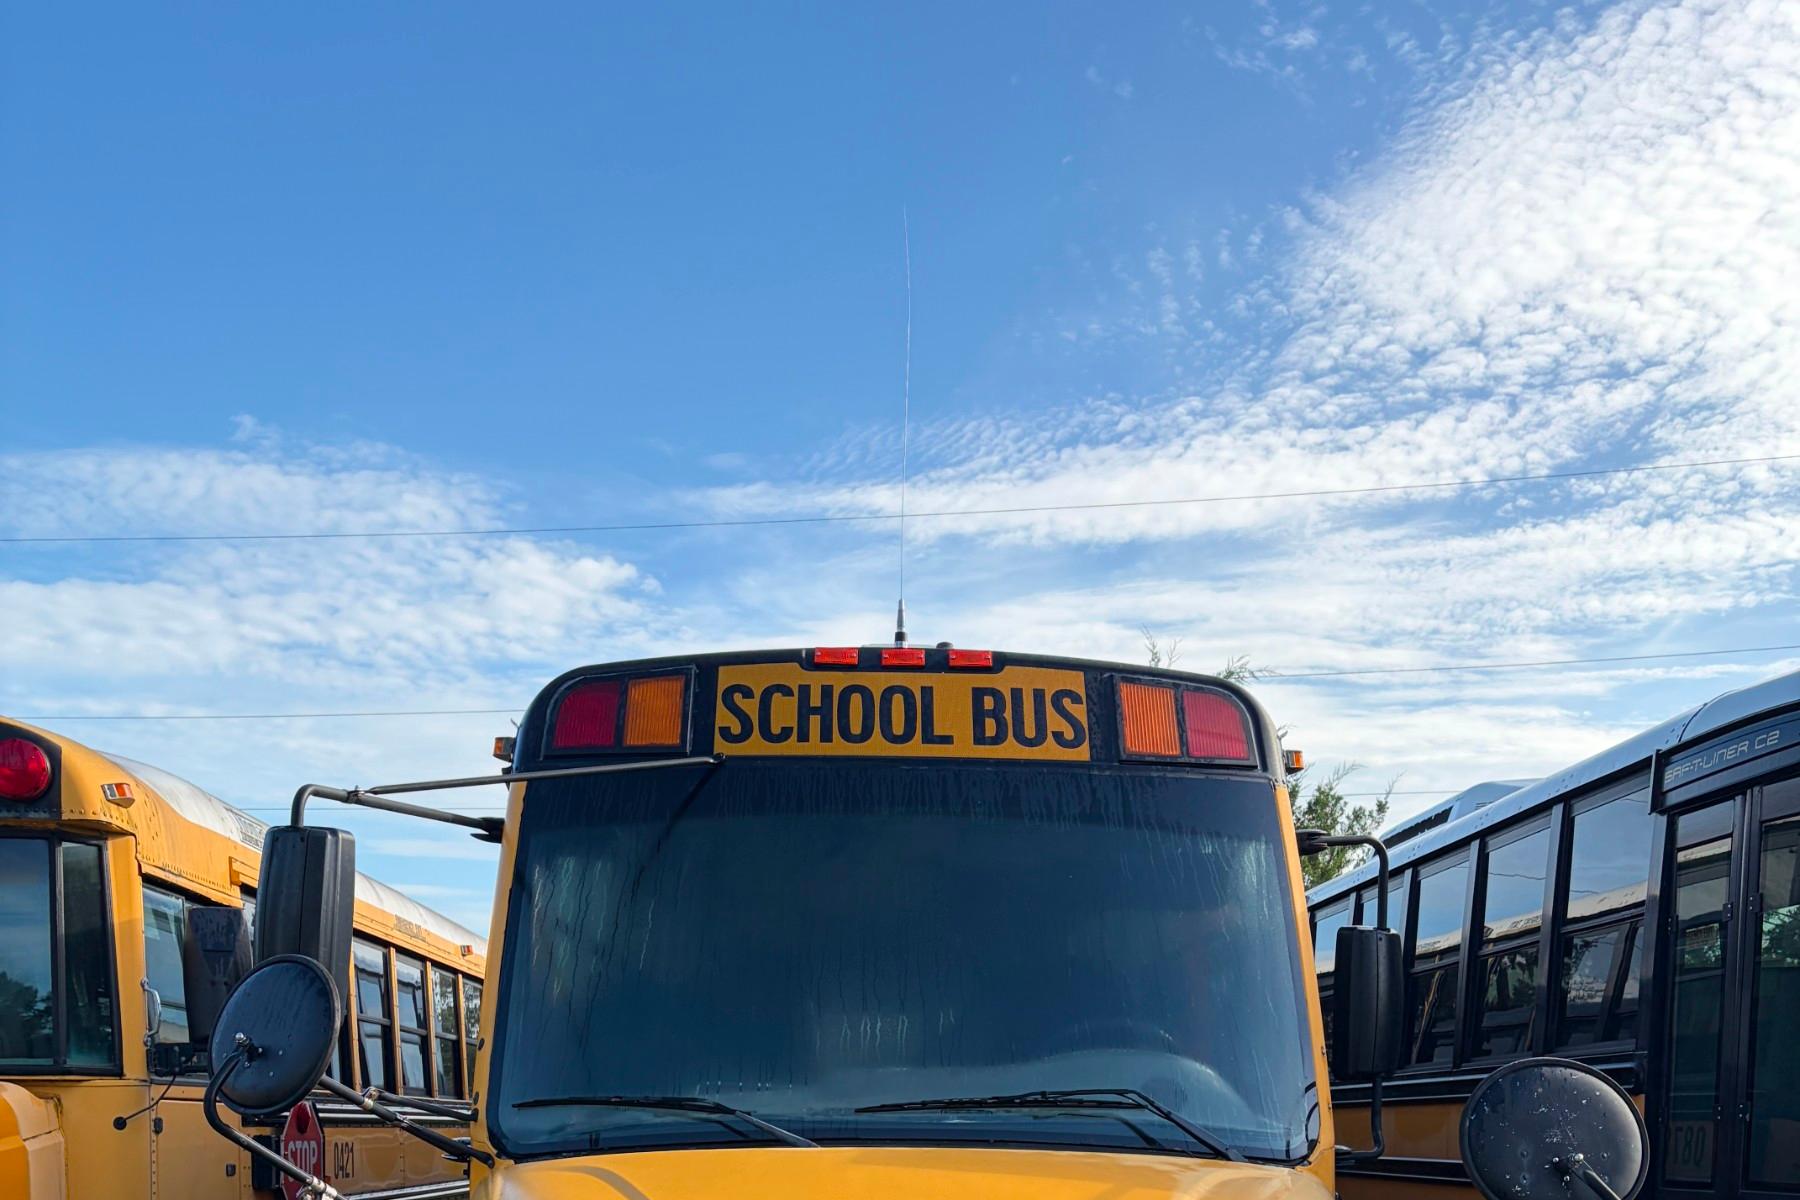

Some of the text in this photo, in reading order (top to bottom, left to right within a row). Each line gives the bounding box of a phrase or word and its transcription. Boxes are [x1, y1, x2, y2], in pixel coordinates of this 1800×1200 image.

[718, 683, 1087, 749] SCHOOL BUS
[1754, 730, 1780, 750] C2
[287, 1140, 318, 1182] STOP
[333, 1142, 355, 1179] 0421
